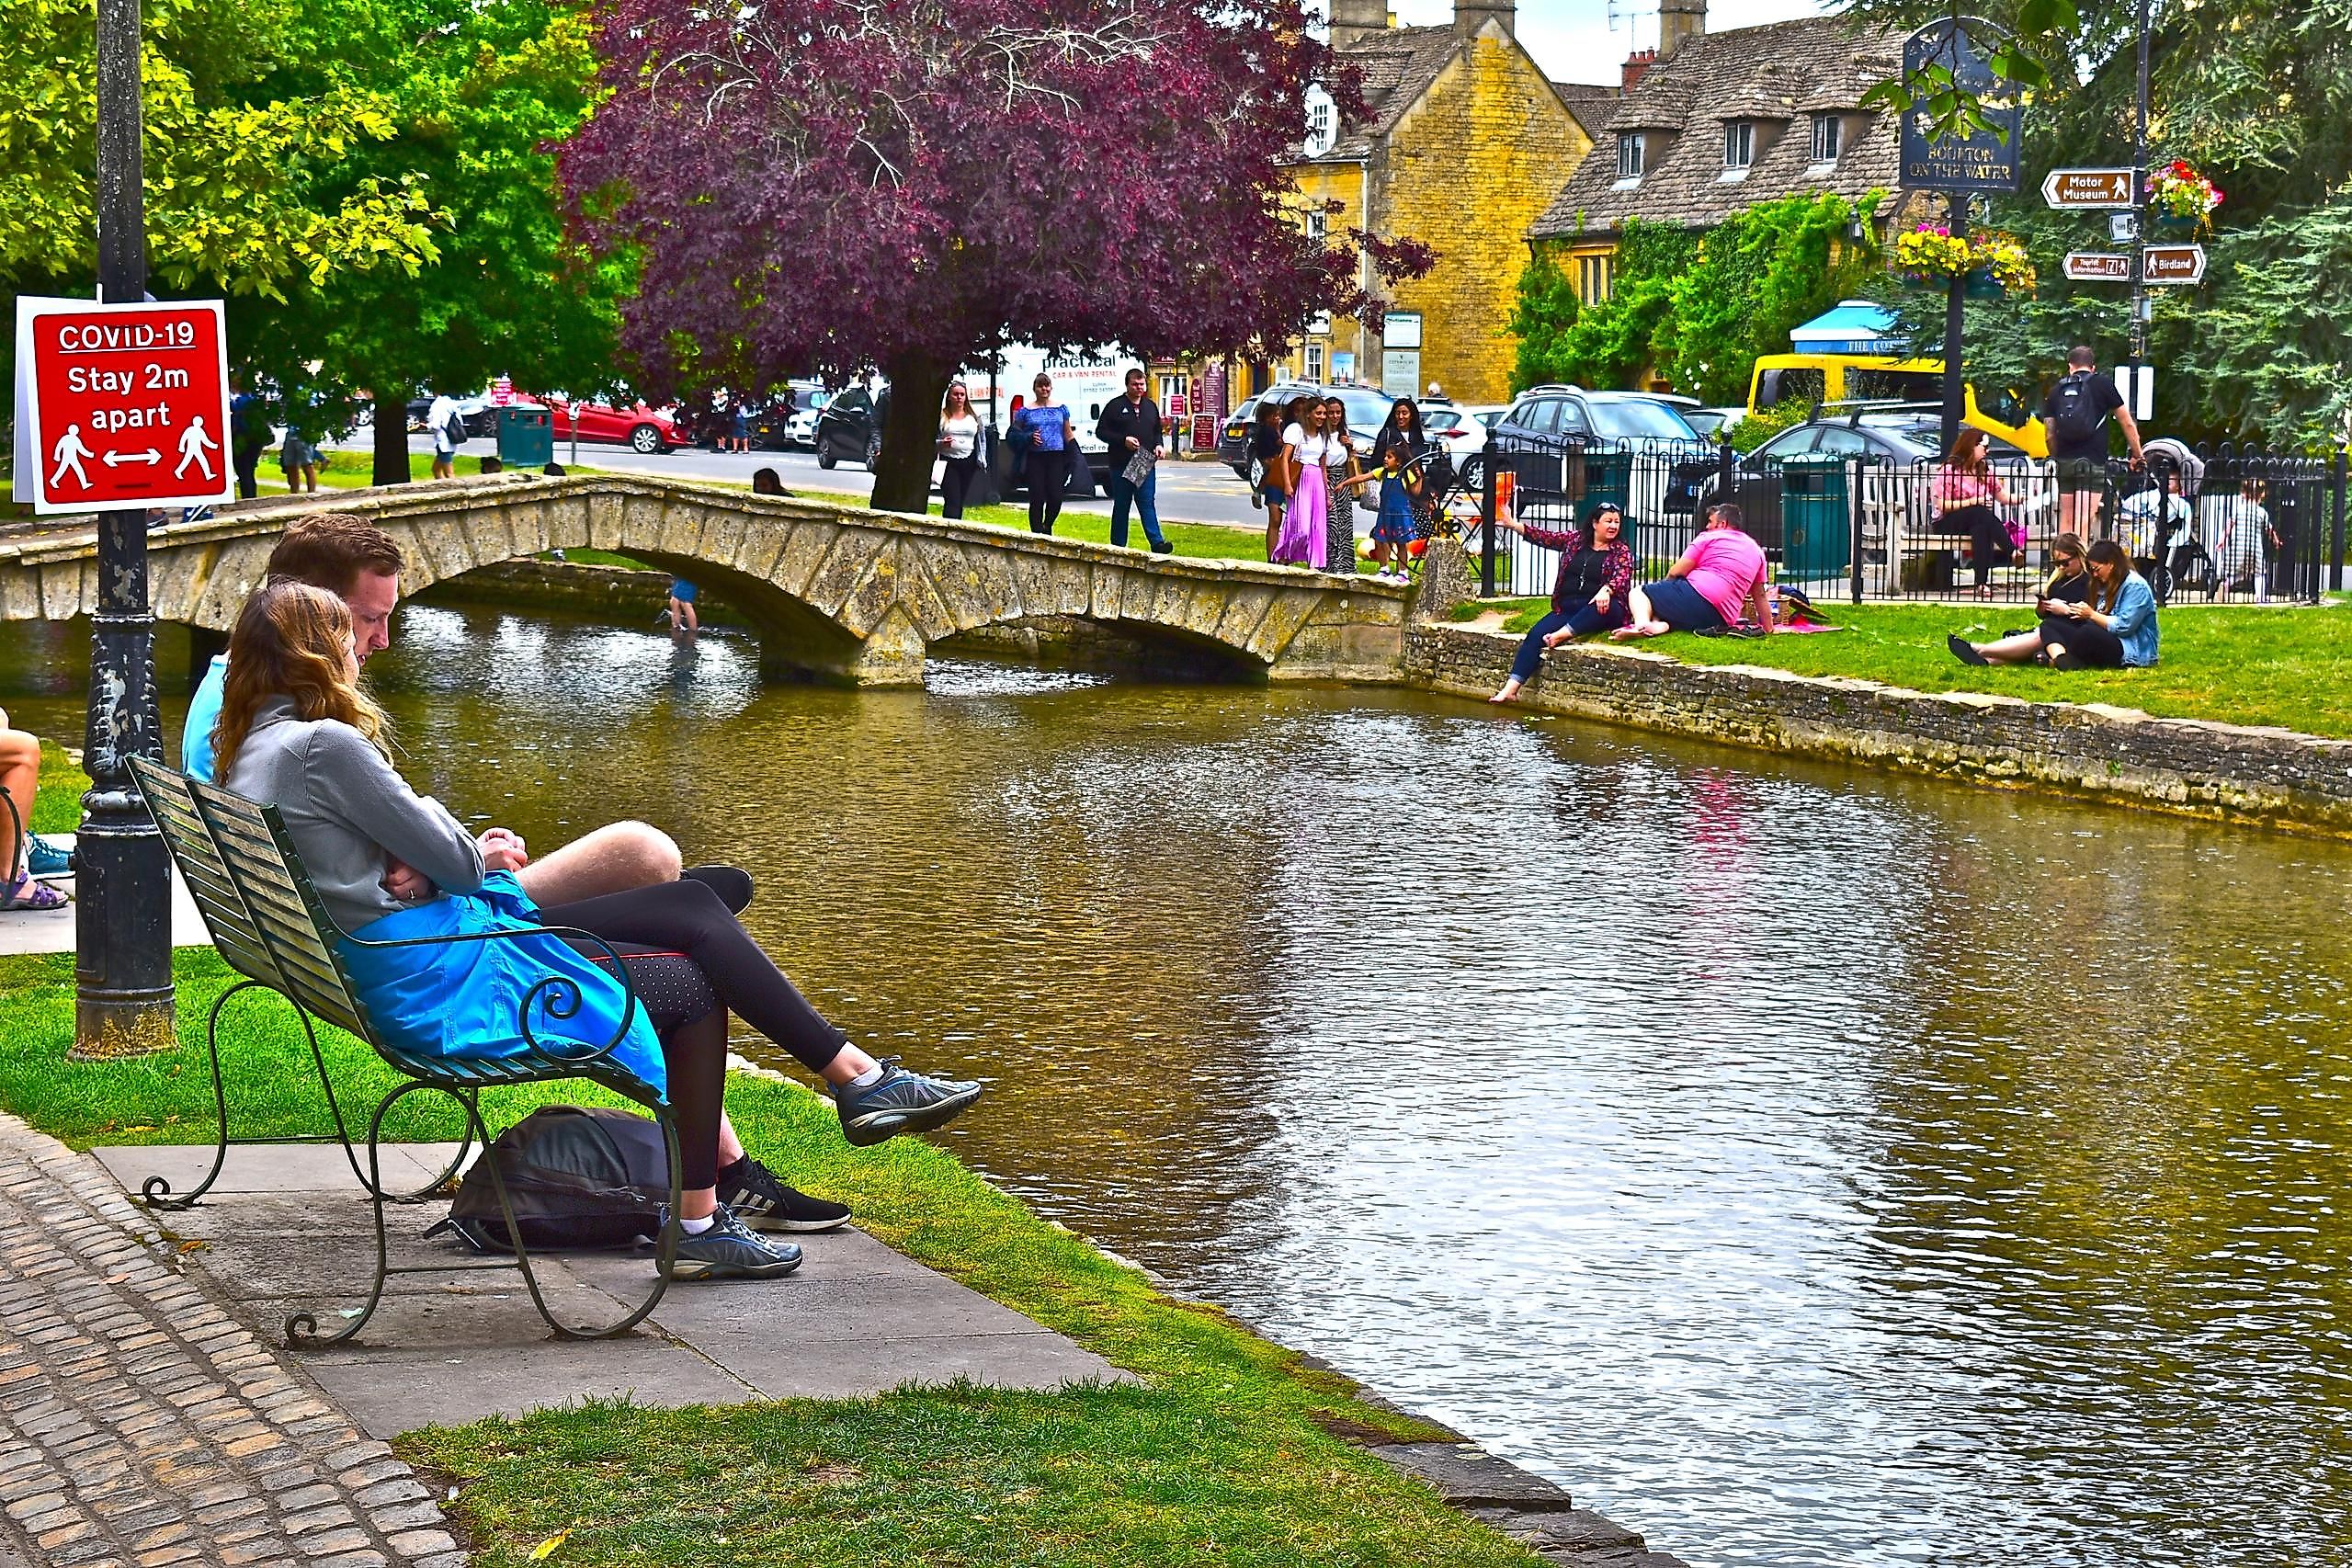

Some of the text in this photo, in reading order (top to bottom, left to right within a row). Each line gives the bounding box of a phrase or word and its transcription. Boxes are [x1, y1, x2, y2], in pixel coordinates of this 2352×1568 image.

[1909, 162, 2011, 180] ON THE WATER
[2069, 176, 2103, 188] Motor
[2062, 188, 2108, 200] Museum
[2079, 258, 2100, 267] Tourist
[2158, 258, 2191, 270] Birdland
[58, 322, 195, 350] COVID-19
[1846, 340, 1869, 352] THE
[68, 363, 189, 395] Stay 2m
[91, 401, 171, 434] apart
